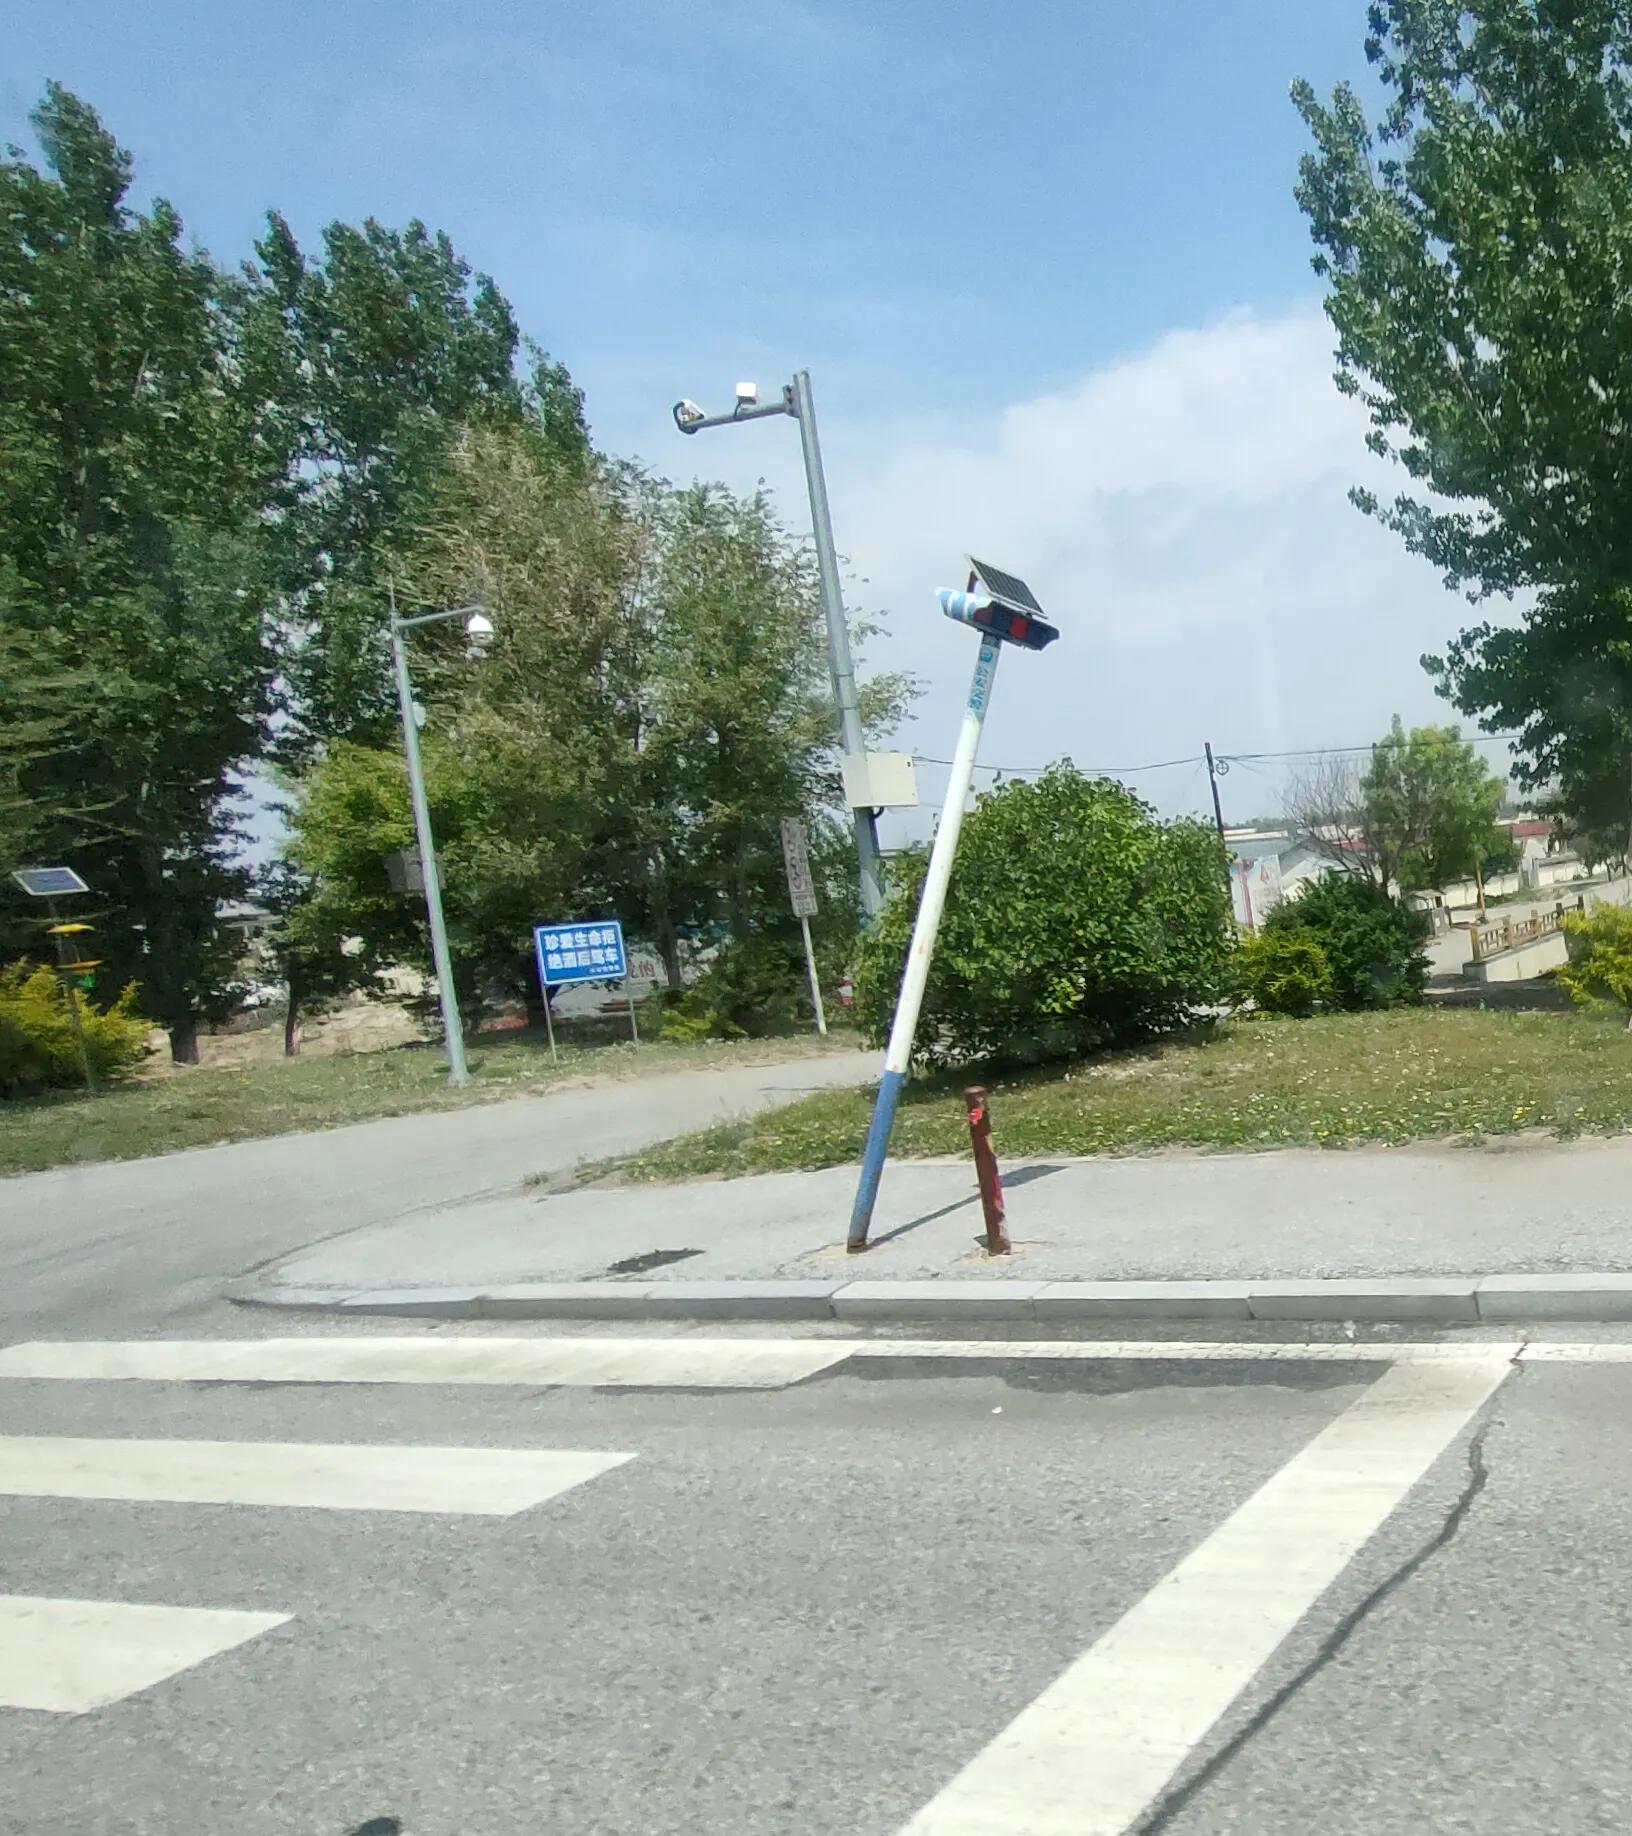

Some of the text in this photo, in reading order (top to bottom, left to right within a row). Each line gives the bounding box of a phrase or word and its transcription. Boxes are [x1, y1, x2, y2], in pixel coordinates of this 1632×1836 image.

[545, 930, 616, 950] 珍爱生命拒
